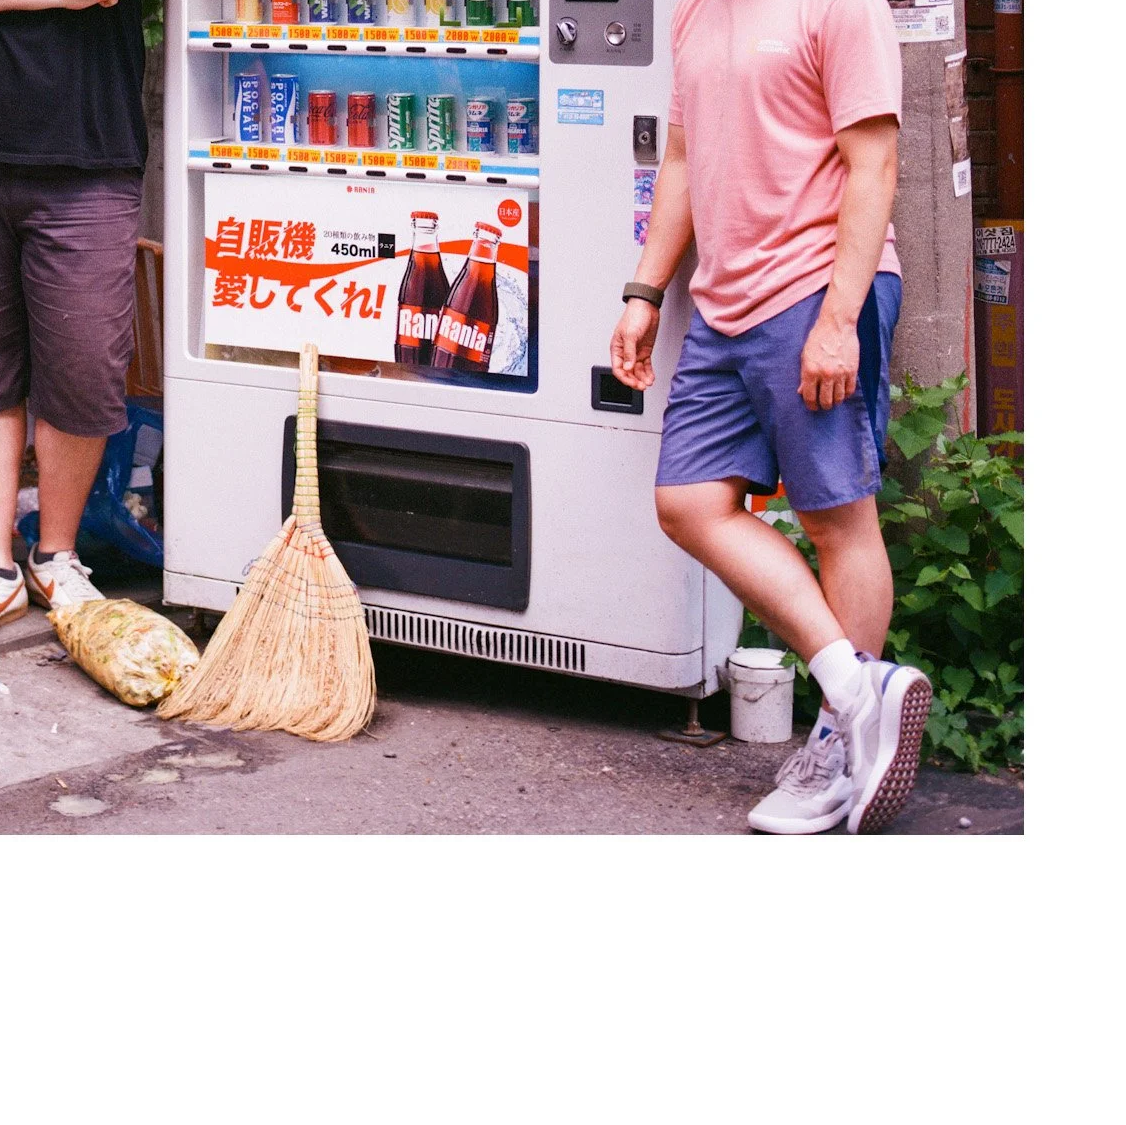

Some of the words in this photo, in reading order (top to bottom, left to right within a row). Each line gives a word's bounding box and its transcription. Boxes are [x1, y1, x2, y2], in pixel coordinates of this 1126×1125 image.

[242, 80, 252, 133] SWEAT
[251, 80, 259, 139] POCRI
[275, 82, 284, 141] POCARI
[216, 216, 316, 261] 自販機
[331, 242, 376, 258] 450ml
[398, 308, 439, 341] Ran
[438, 314, 488, 353] Rania
